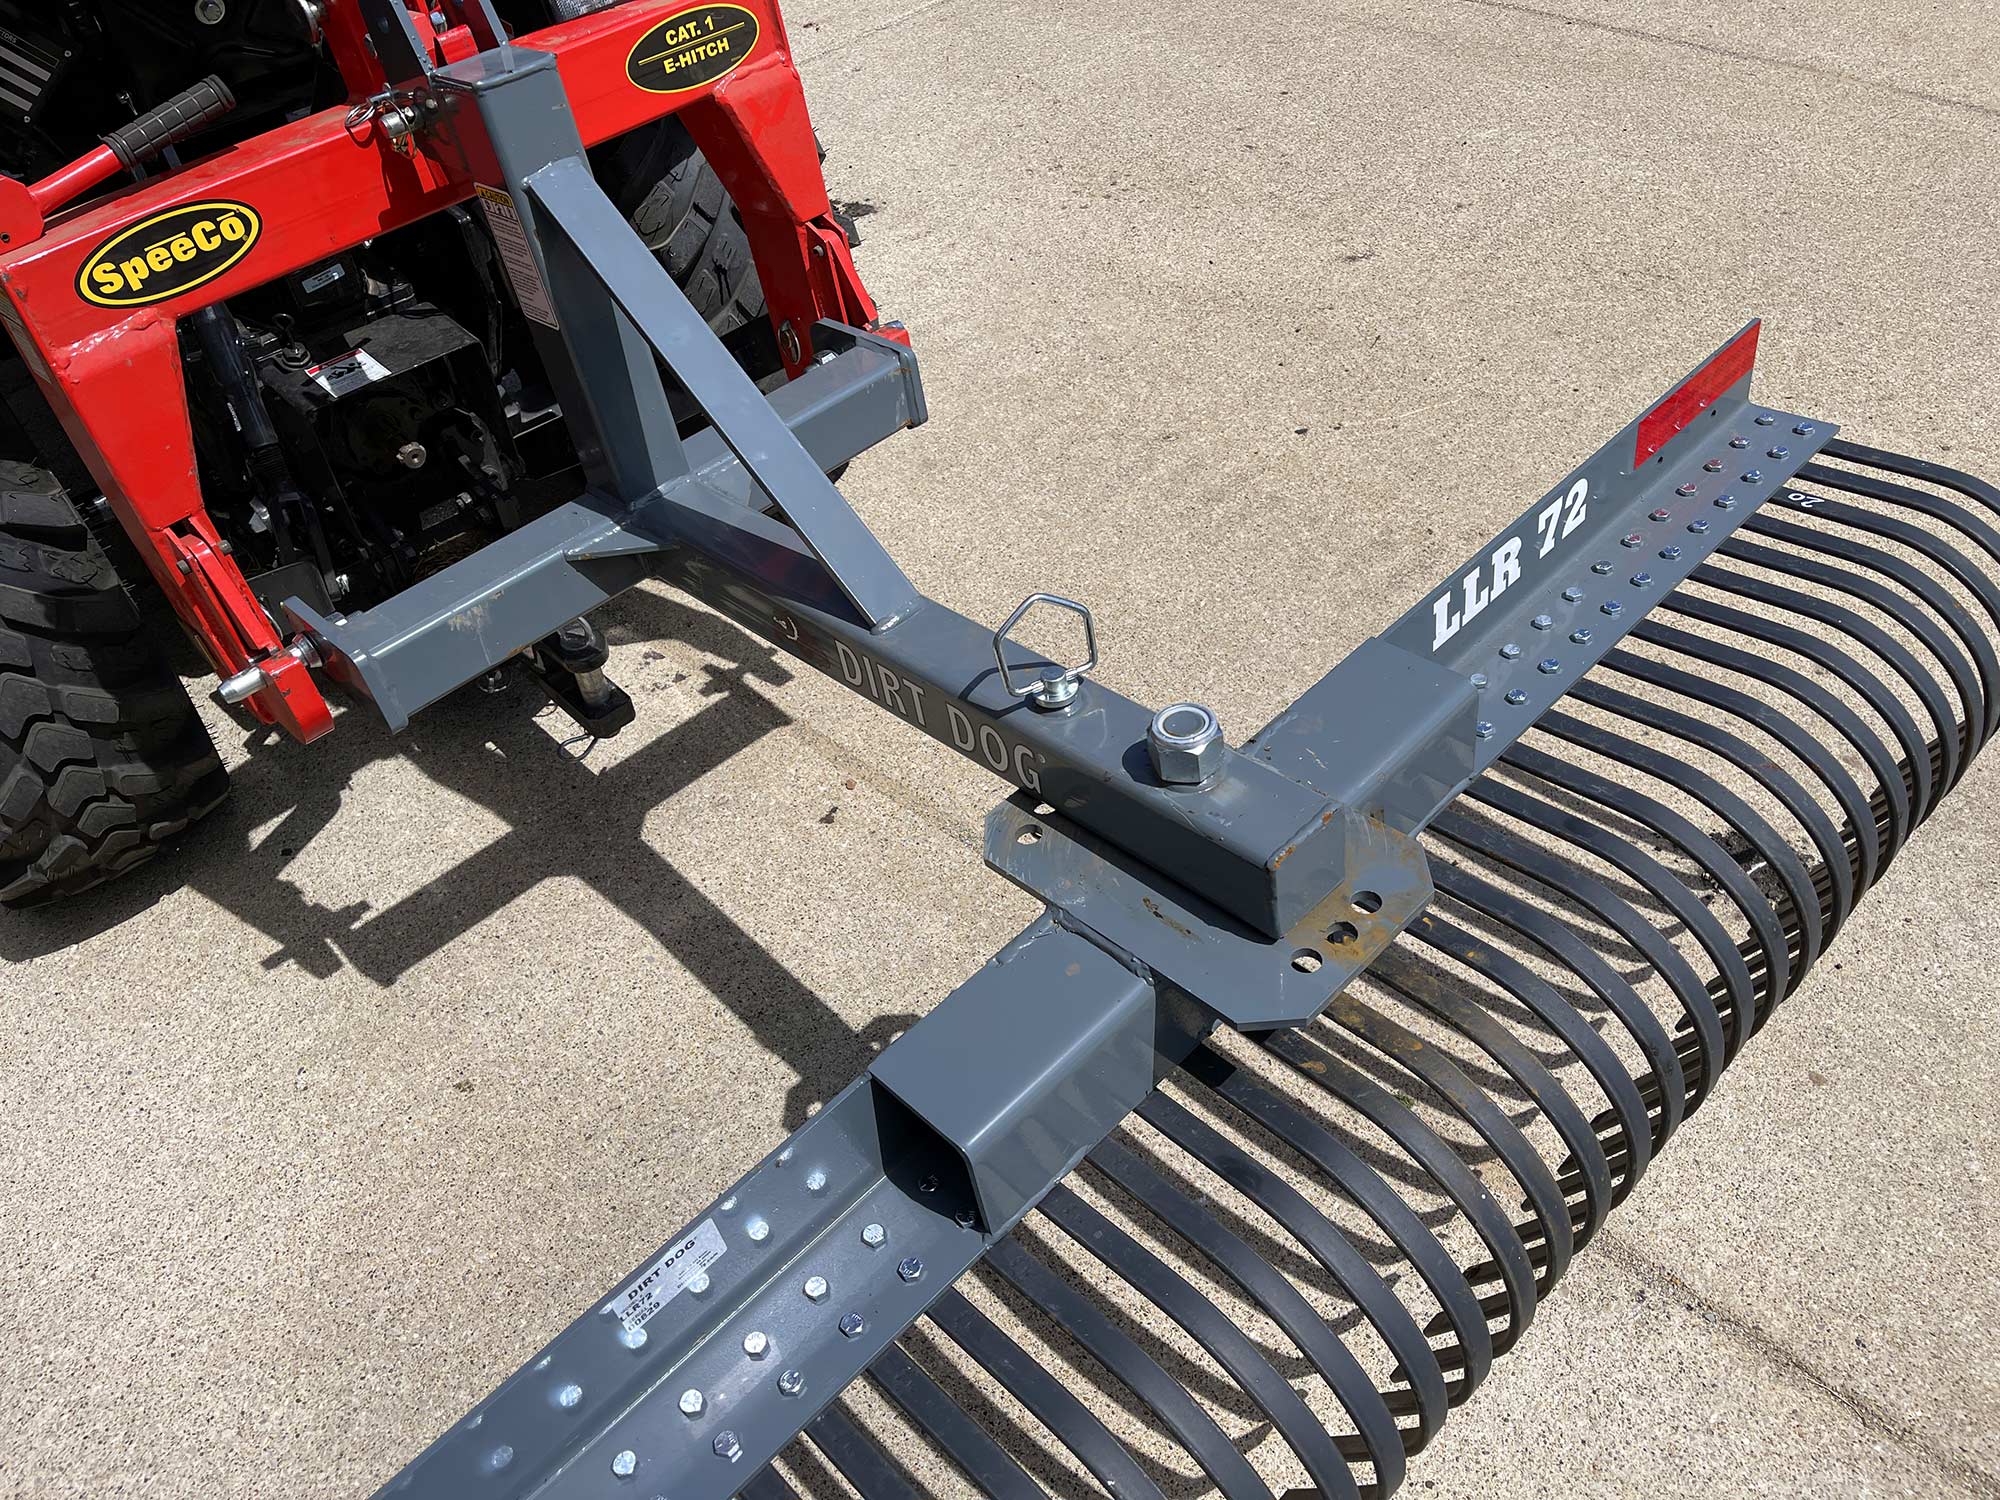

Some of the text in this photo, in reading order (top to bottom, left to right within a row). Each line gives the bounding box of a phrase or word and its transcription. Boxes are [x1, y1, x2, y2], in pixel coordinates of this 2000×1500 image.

[665, 15, 715, 46] CAT. 1
[663, 37, 730, 74] E-HITCH
[1432, 478, 1589, 652] LLR 72
[834, 639, 1042, 795] DIRT DOG
[627, 1267, 661, 1300] DIRT
[664, 1239, 696, 1269] DOG
[619, 1291, 653, 1323] LLR72
